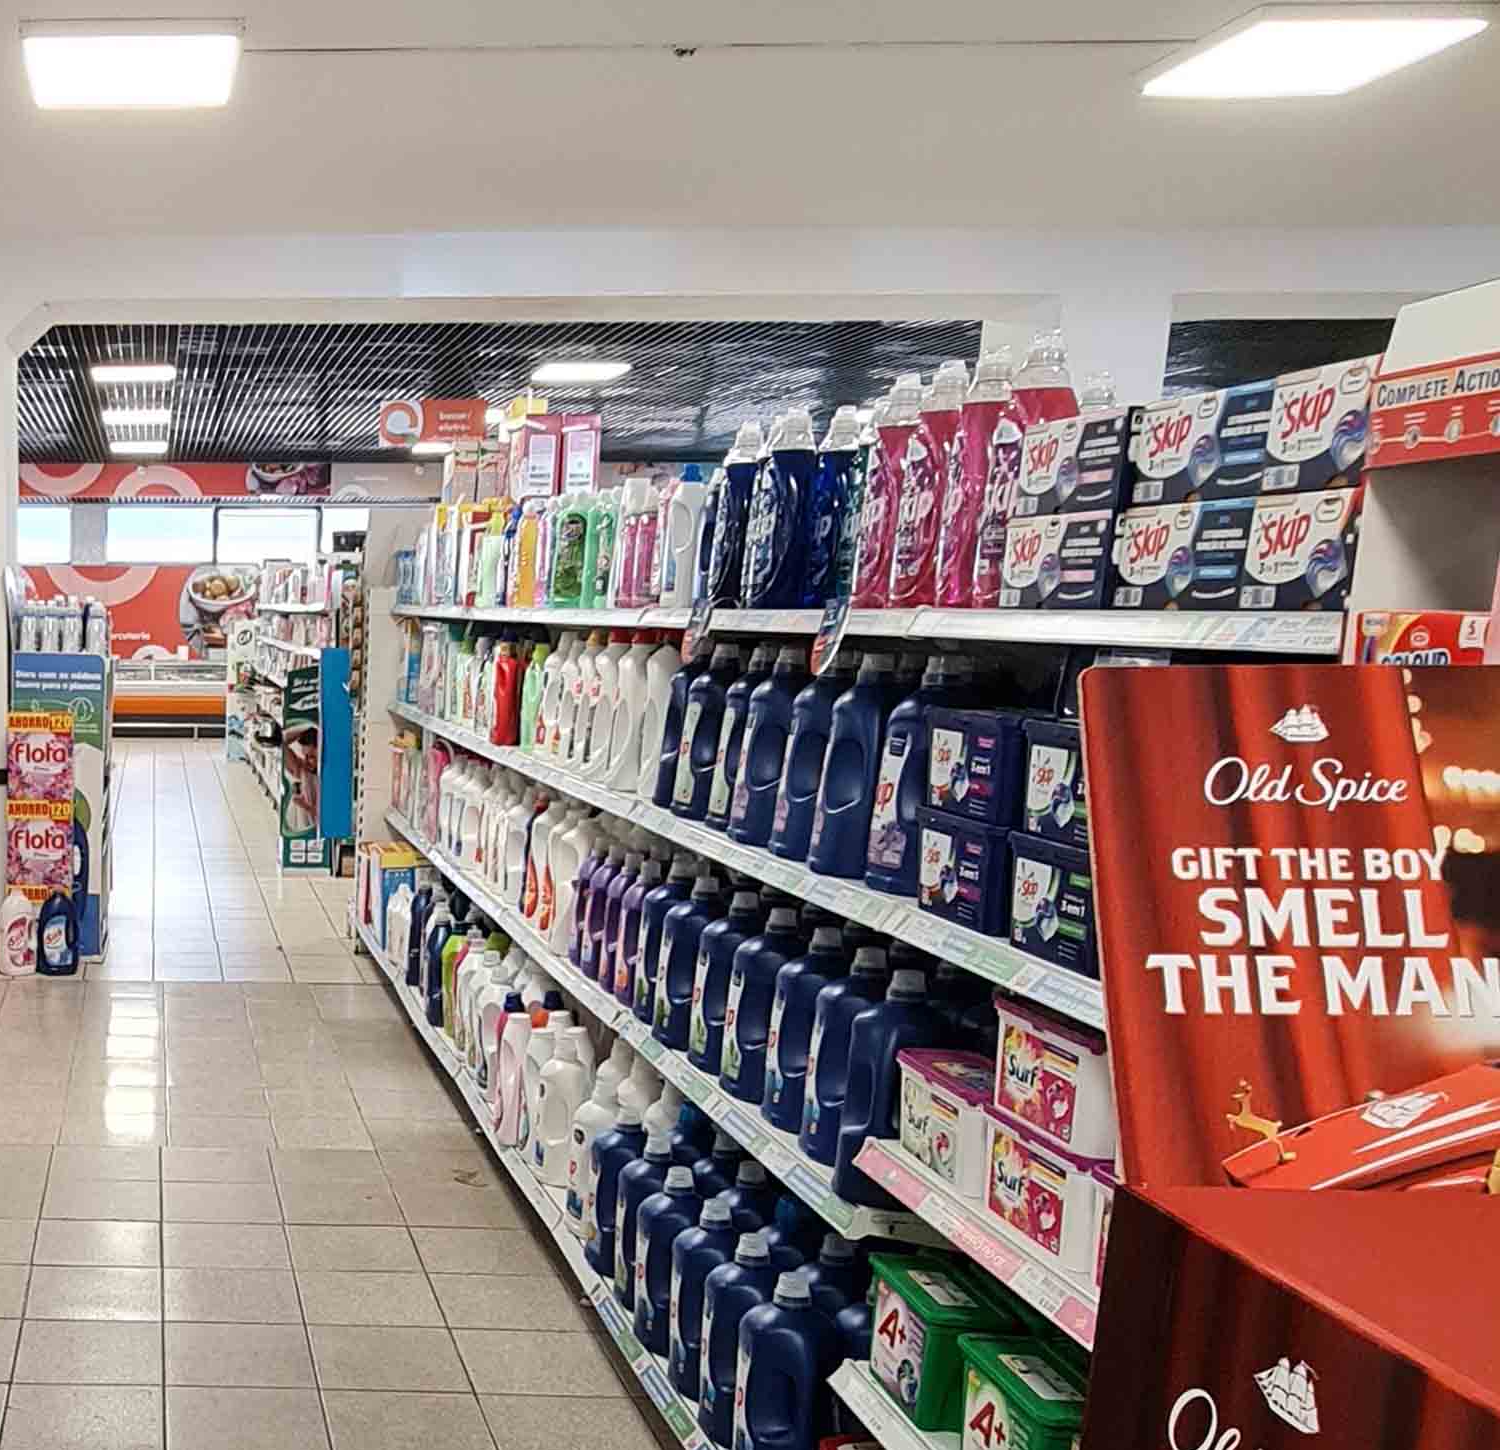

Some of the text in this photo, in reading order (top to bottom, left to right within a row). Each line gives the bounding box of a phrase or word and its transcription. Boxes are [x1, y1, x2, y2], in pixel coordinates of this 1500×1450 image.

[1203, 756, 1409, 812] Old Spice
[1171, 848, 1449, 882] GIFT THE BOY
[1198, 888, 1449, 949] SMELL
[1145, 954, 1500, 1017] THE MAN
[1008, 1055, 1038, 1088] Surf
[905, 1104, 929, 1134] Surf
[997, 1161, 1026, 1196] Surf
[878, 1308, 907, 1348] A+
[969, 1401, 1006, 1449] A+
